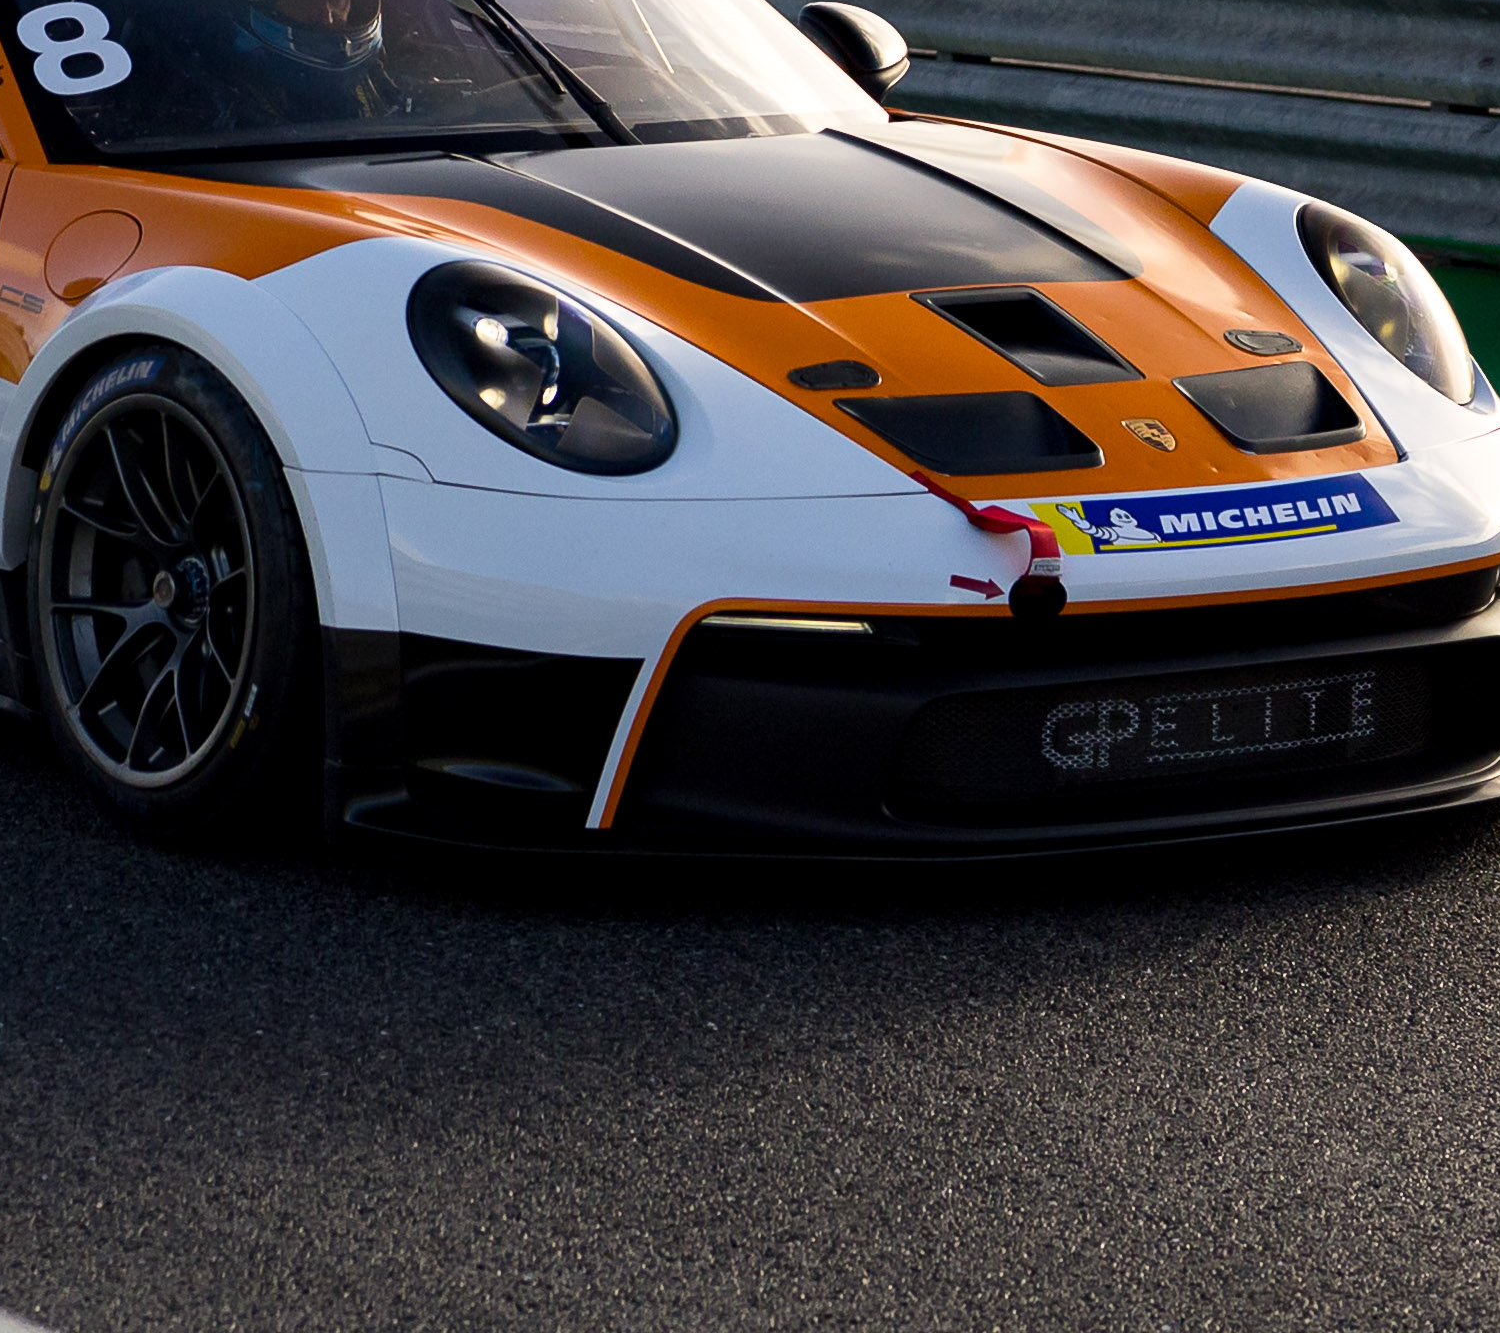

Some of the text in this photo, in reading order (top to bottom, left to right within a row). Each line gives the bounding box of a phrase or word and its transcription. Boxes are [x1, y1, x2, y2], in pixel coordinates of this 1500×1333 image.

[16, 2, 133, 95] 8
[61, 360, 154, 443] MICHELIN
[1158, 492, 1362, 535] MICHELIN
